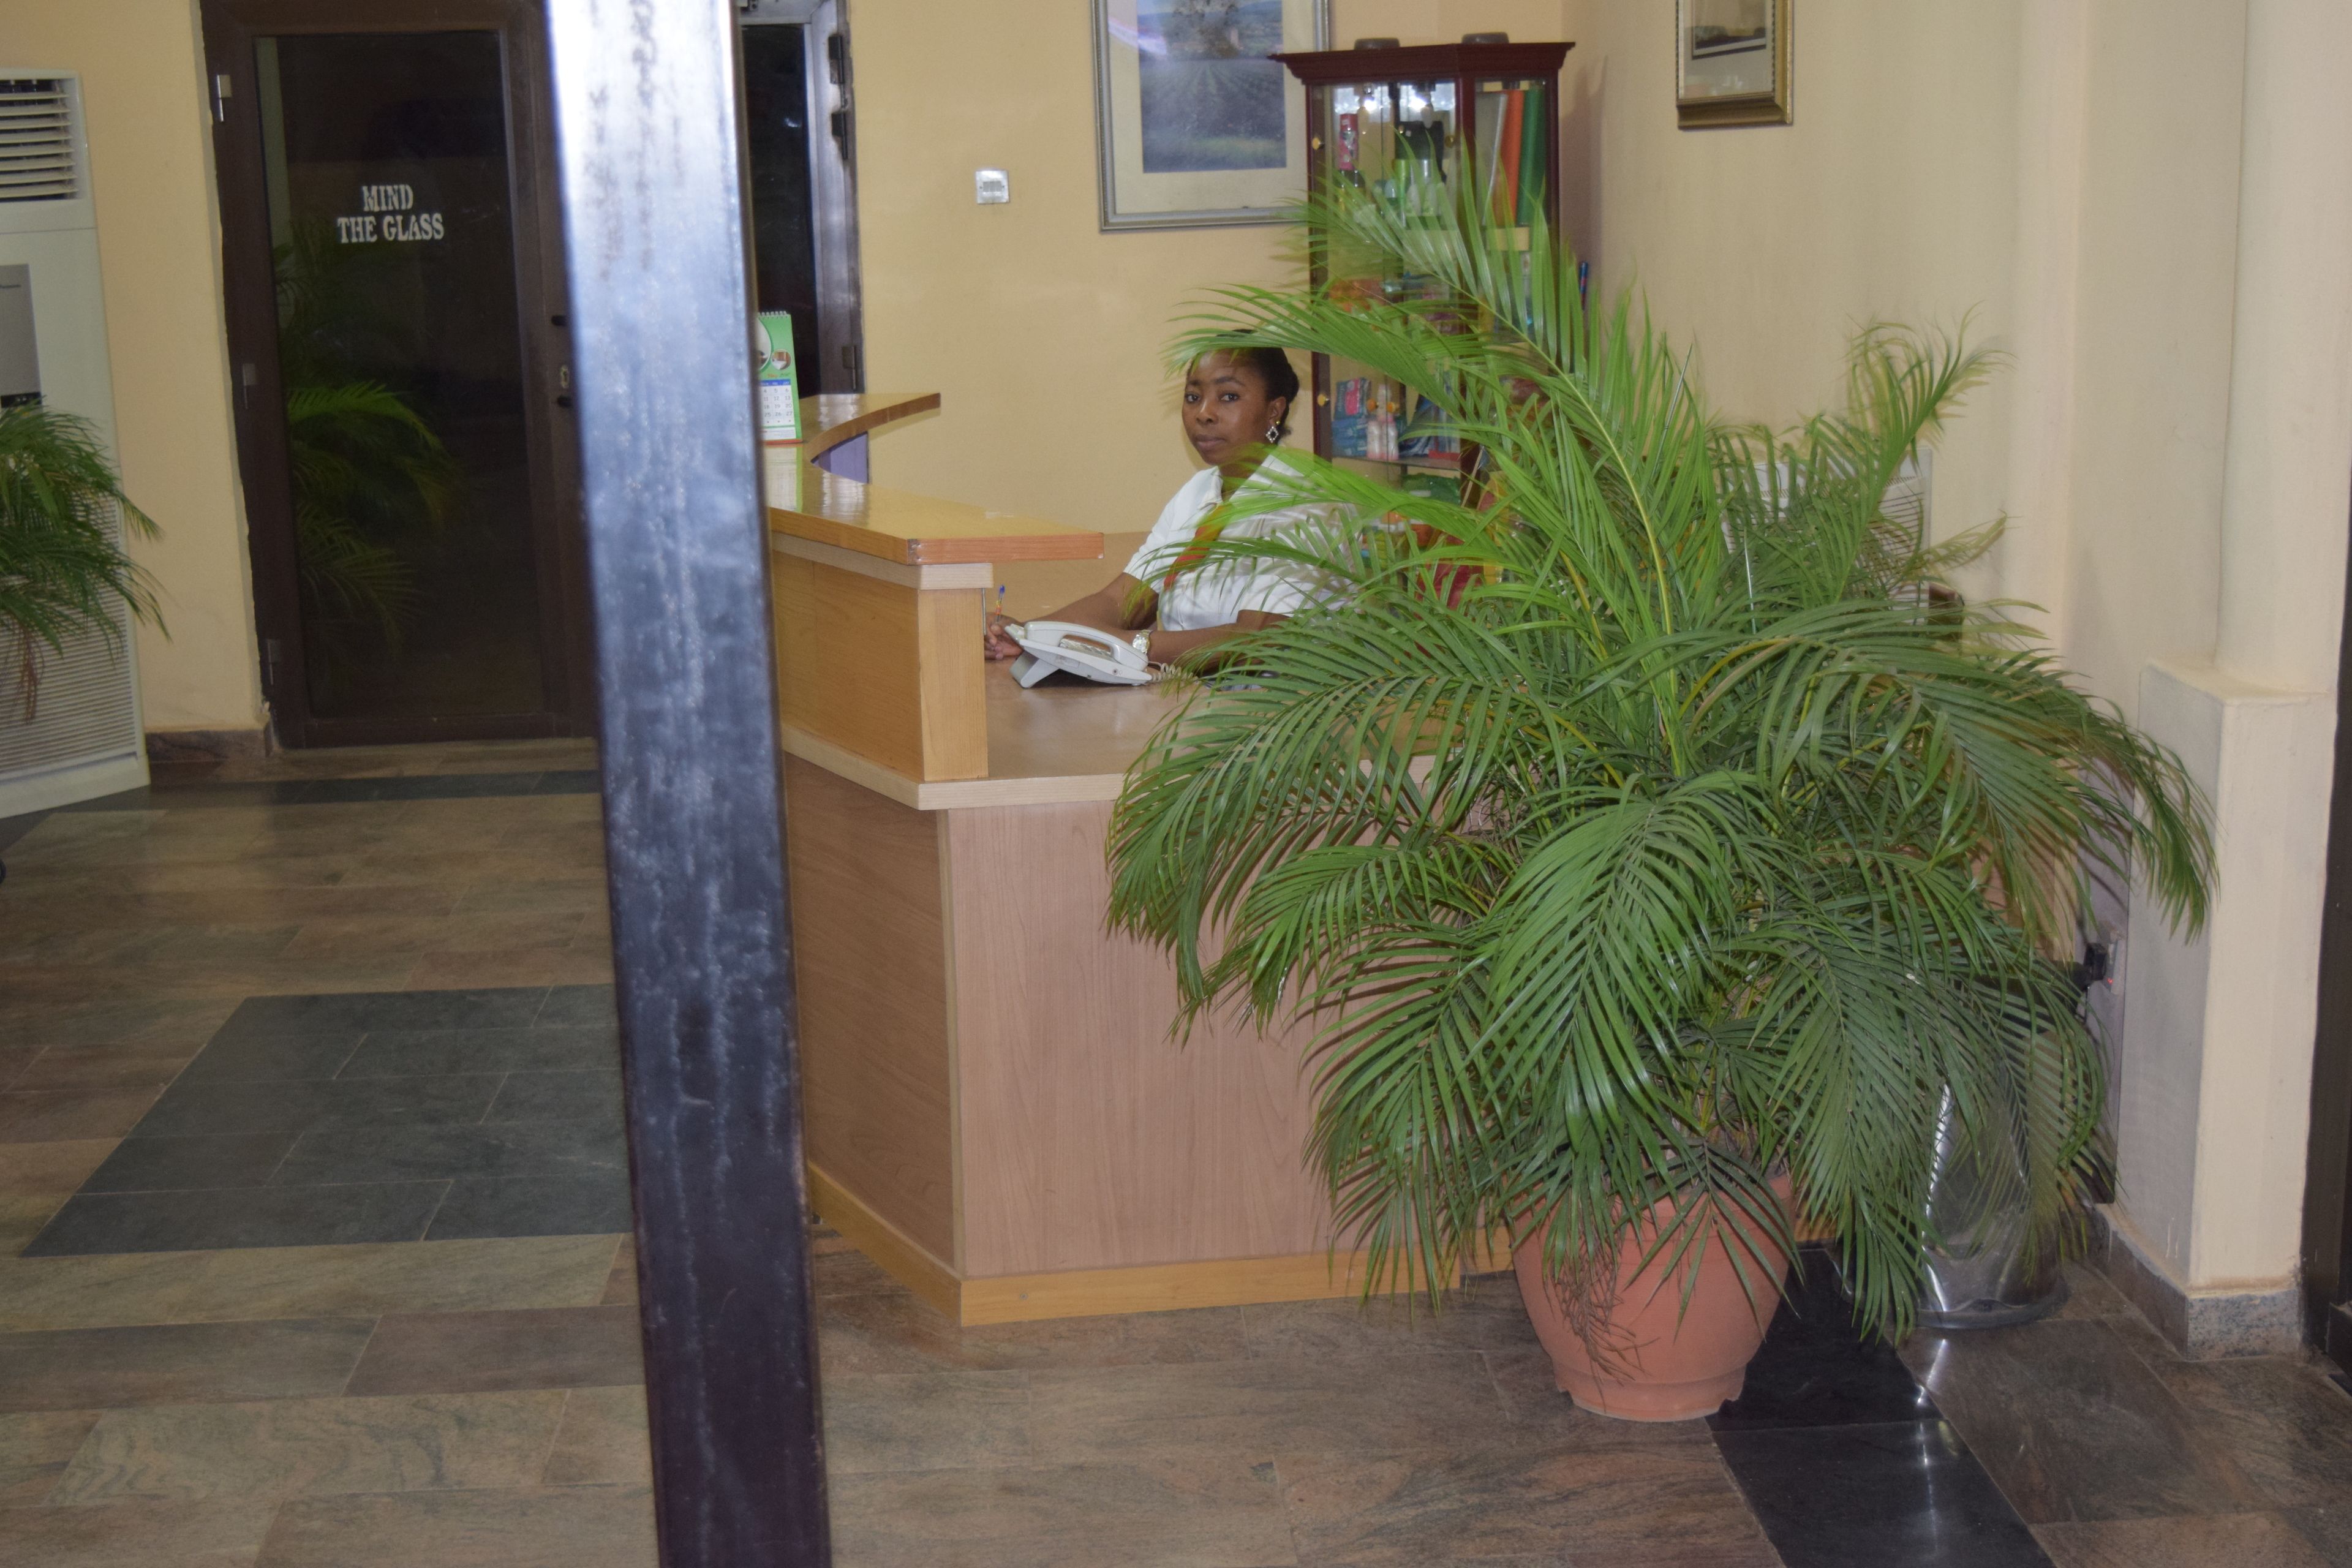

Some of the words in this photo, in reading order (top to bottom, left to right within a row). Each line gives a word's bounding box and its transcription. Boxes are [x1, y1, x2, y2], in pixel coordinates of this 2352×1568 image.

[363, 184, 413, 212] MIND
[337, 216, 377, 244] THE
[383, 213, 445, 241] GLASS
